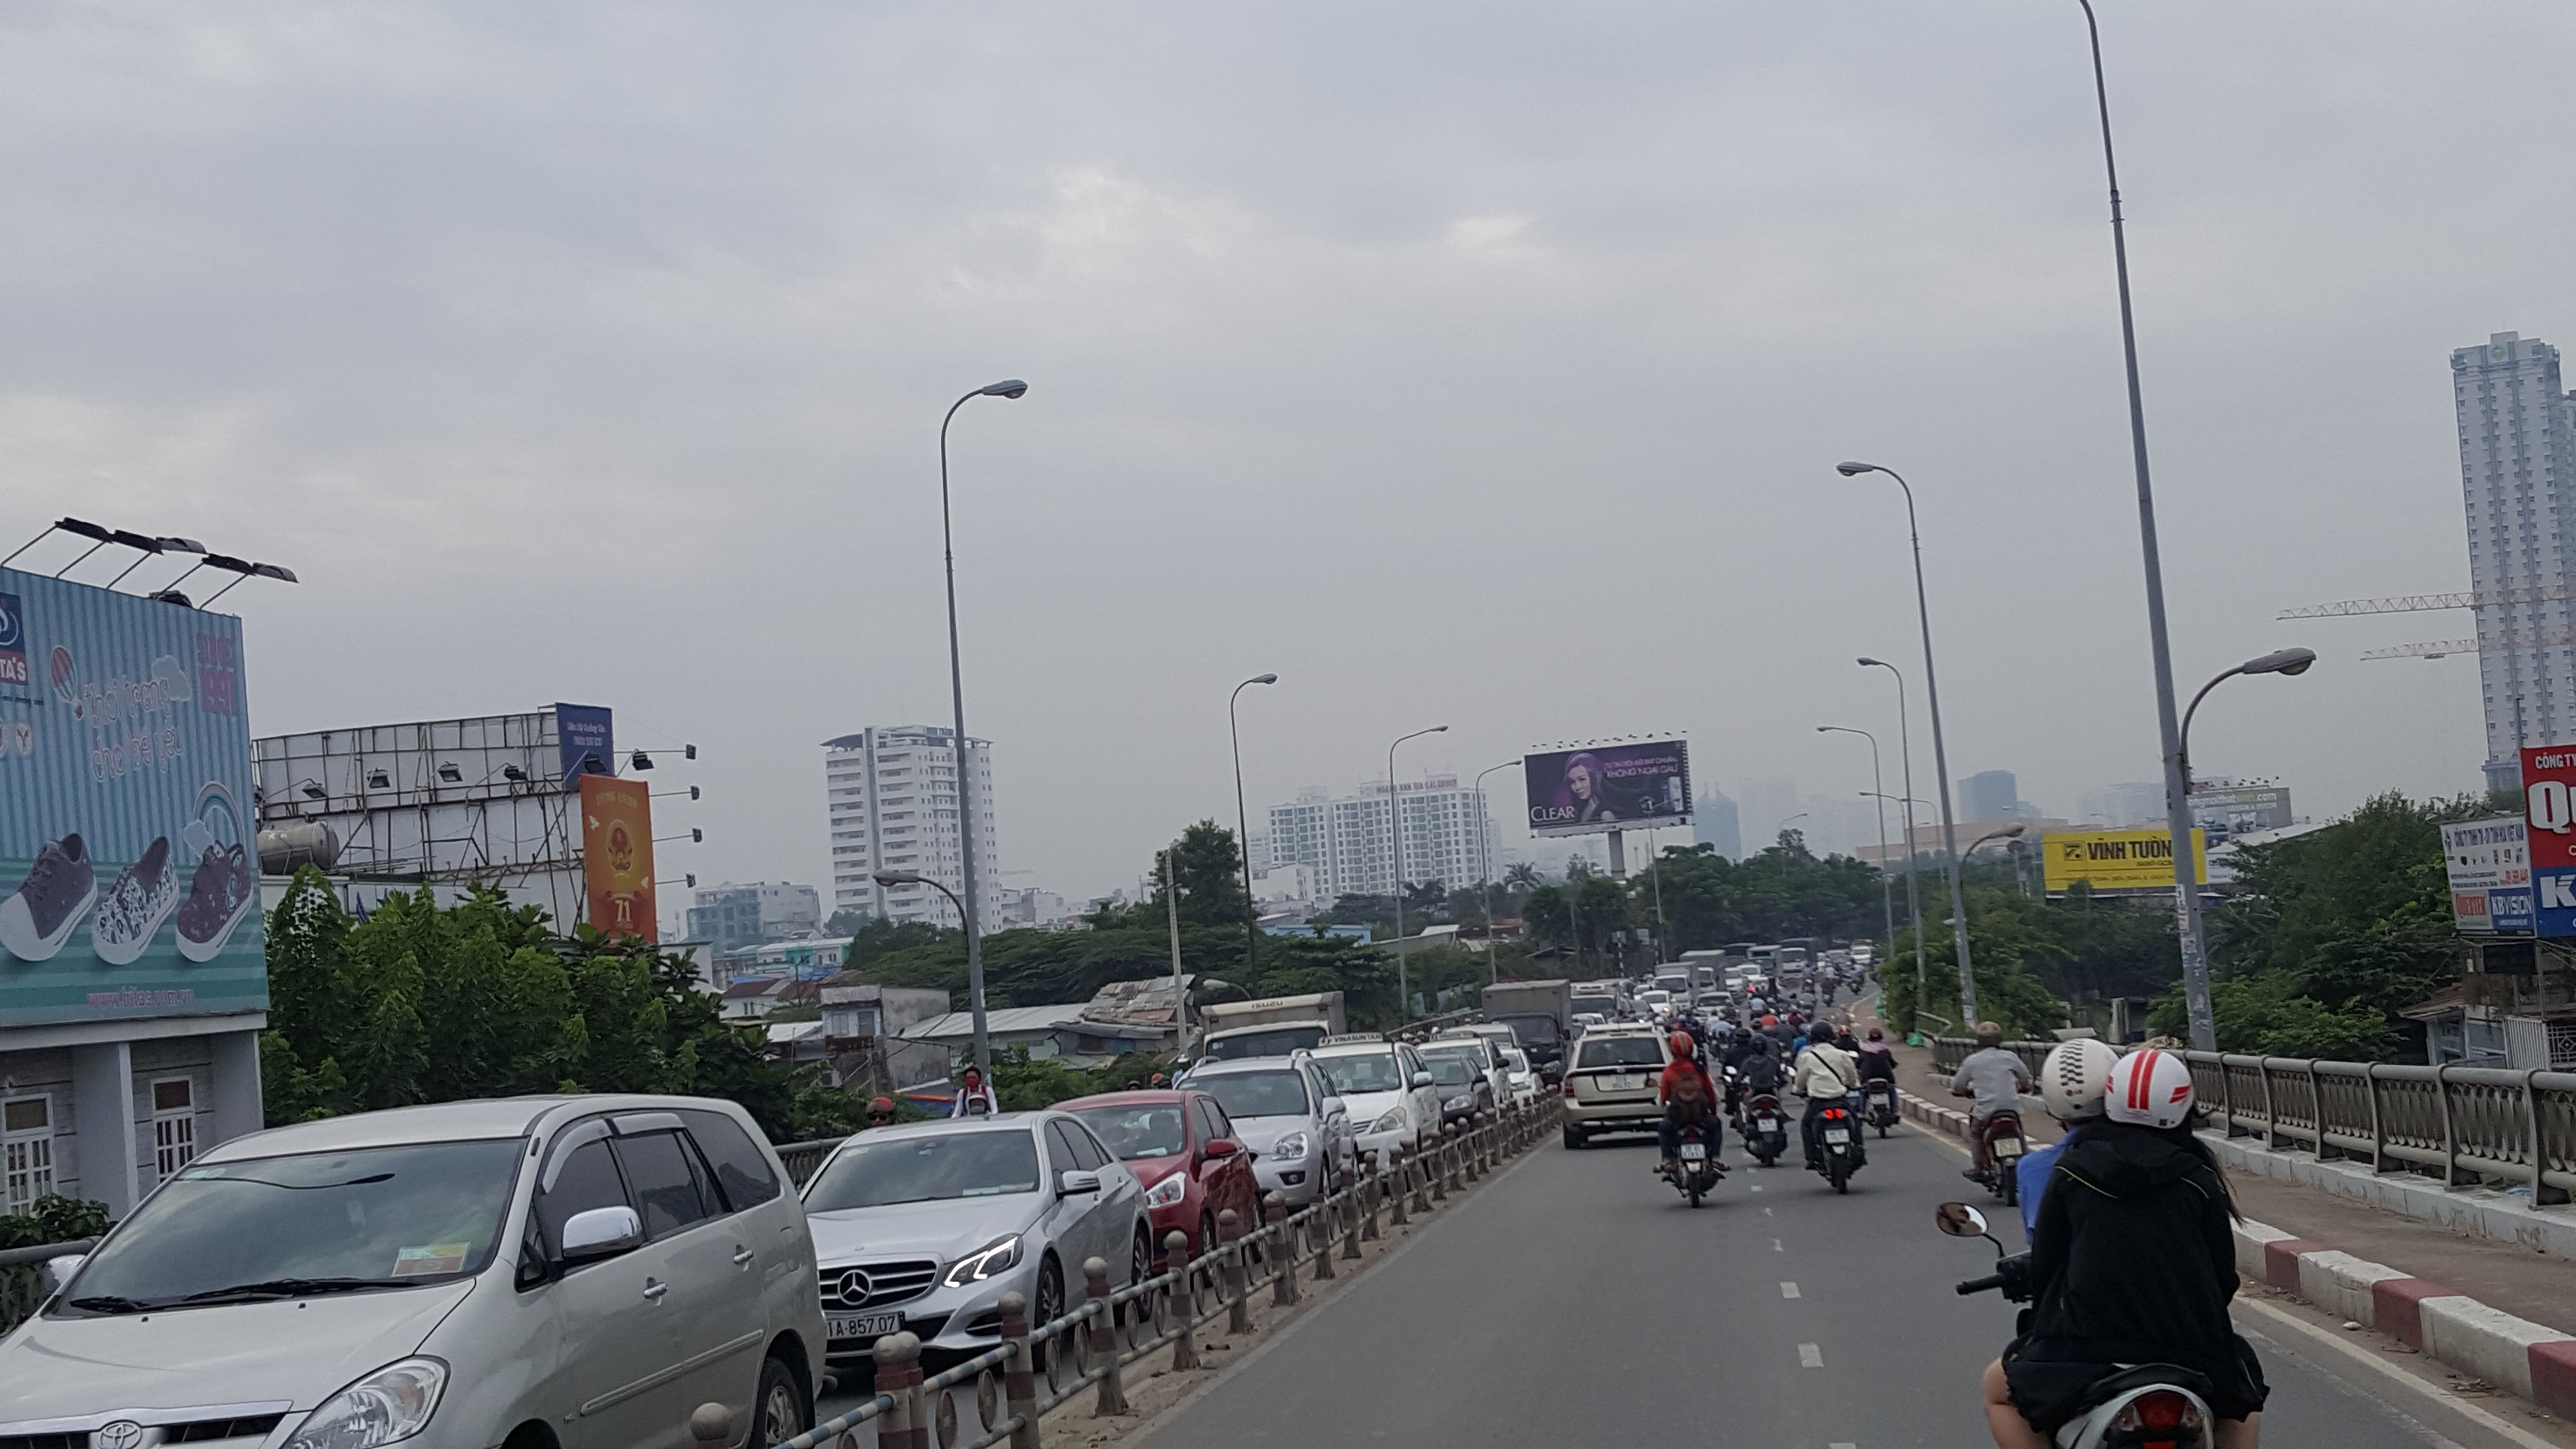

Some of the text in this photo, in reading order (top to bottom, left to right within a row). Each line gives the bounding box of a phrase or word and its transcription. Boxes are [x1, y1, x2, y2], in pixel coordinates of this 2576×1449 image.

[198, 667, 237, 716] 1991
[93, 734, 125, 782] cho
[2535, 752, 2563, 769] CÔNG
[1530, 806, 1575, 821] CLEAR
[2528, 781, 2576, 834] Q
[2087, 837, 2126, 860] VĨNH
[2491, 895, 2532, 915] KBVISION
